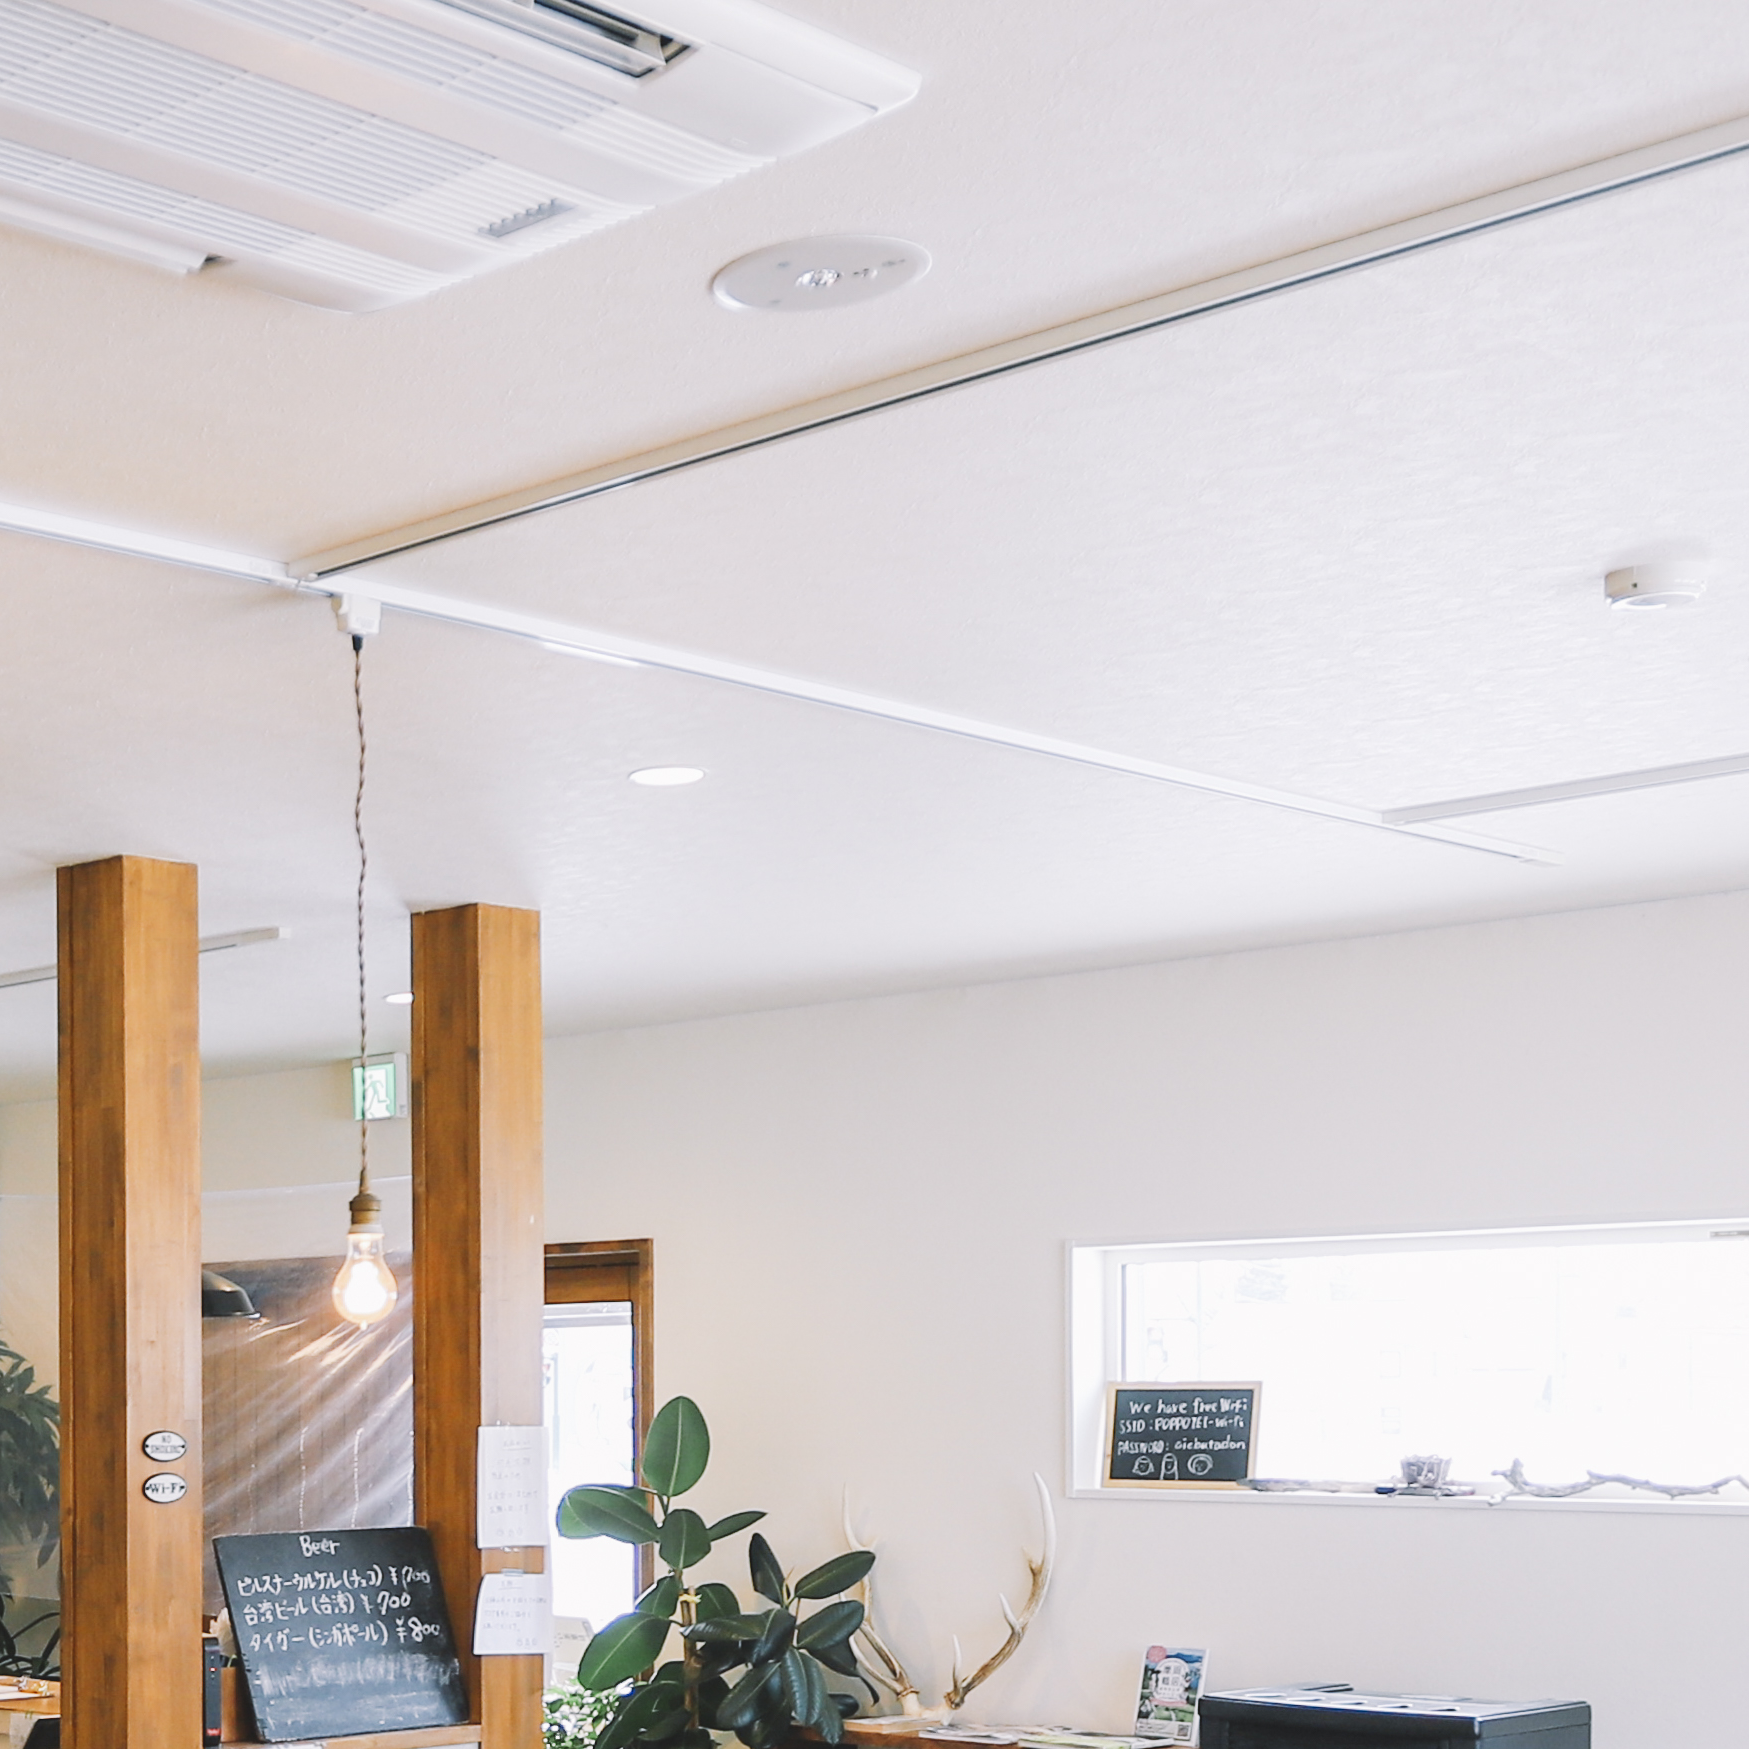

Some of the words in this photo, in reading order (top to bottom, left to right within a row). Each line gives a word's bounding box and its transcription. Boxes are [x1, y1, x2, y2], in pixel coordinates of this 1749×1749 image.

[1129, 1400, 1152, 1414] We
[1156, 1399, 1187, 1414] have
[148, 1482, 183, 1494] Wi-Fi
[299, 1535, 340, 1557] Beer
